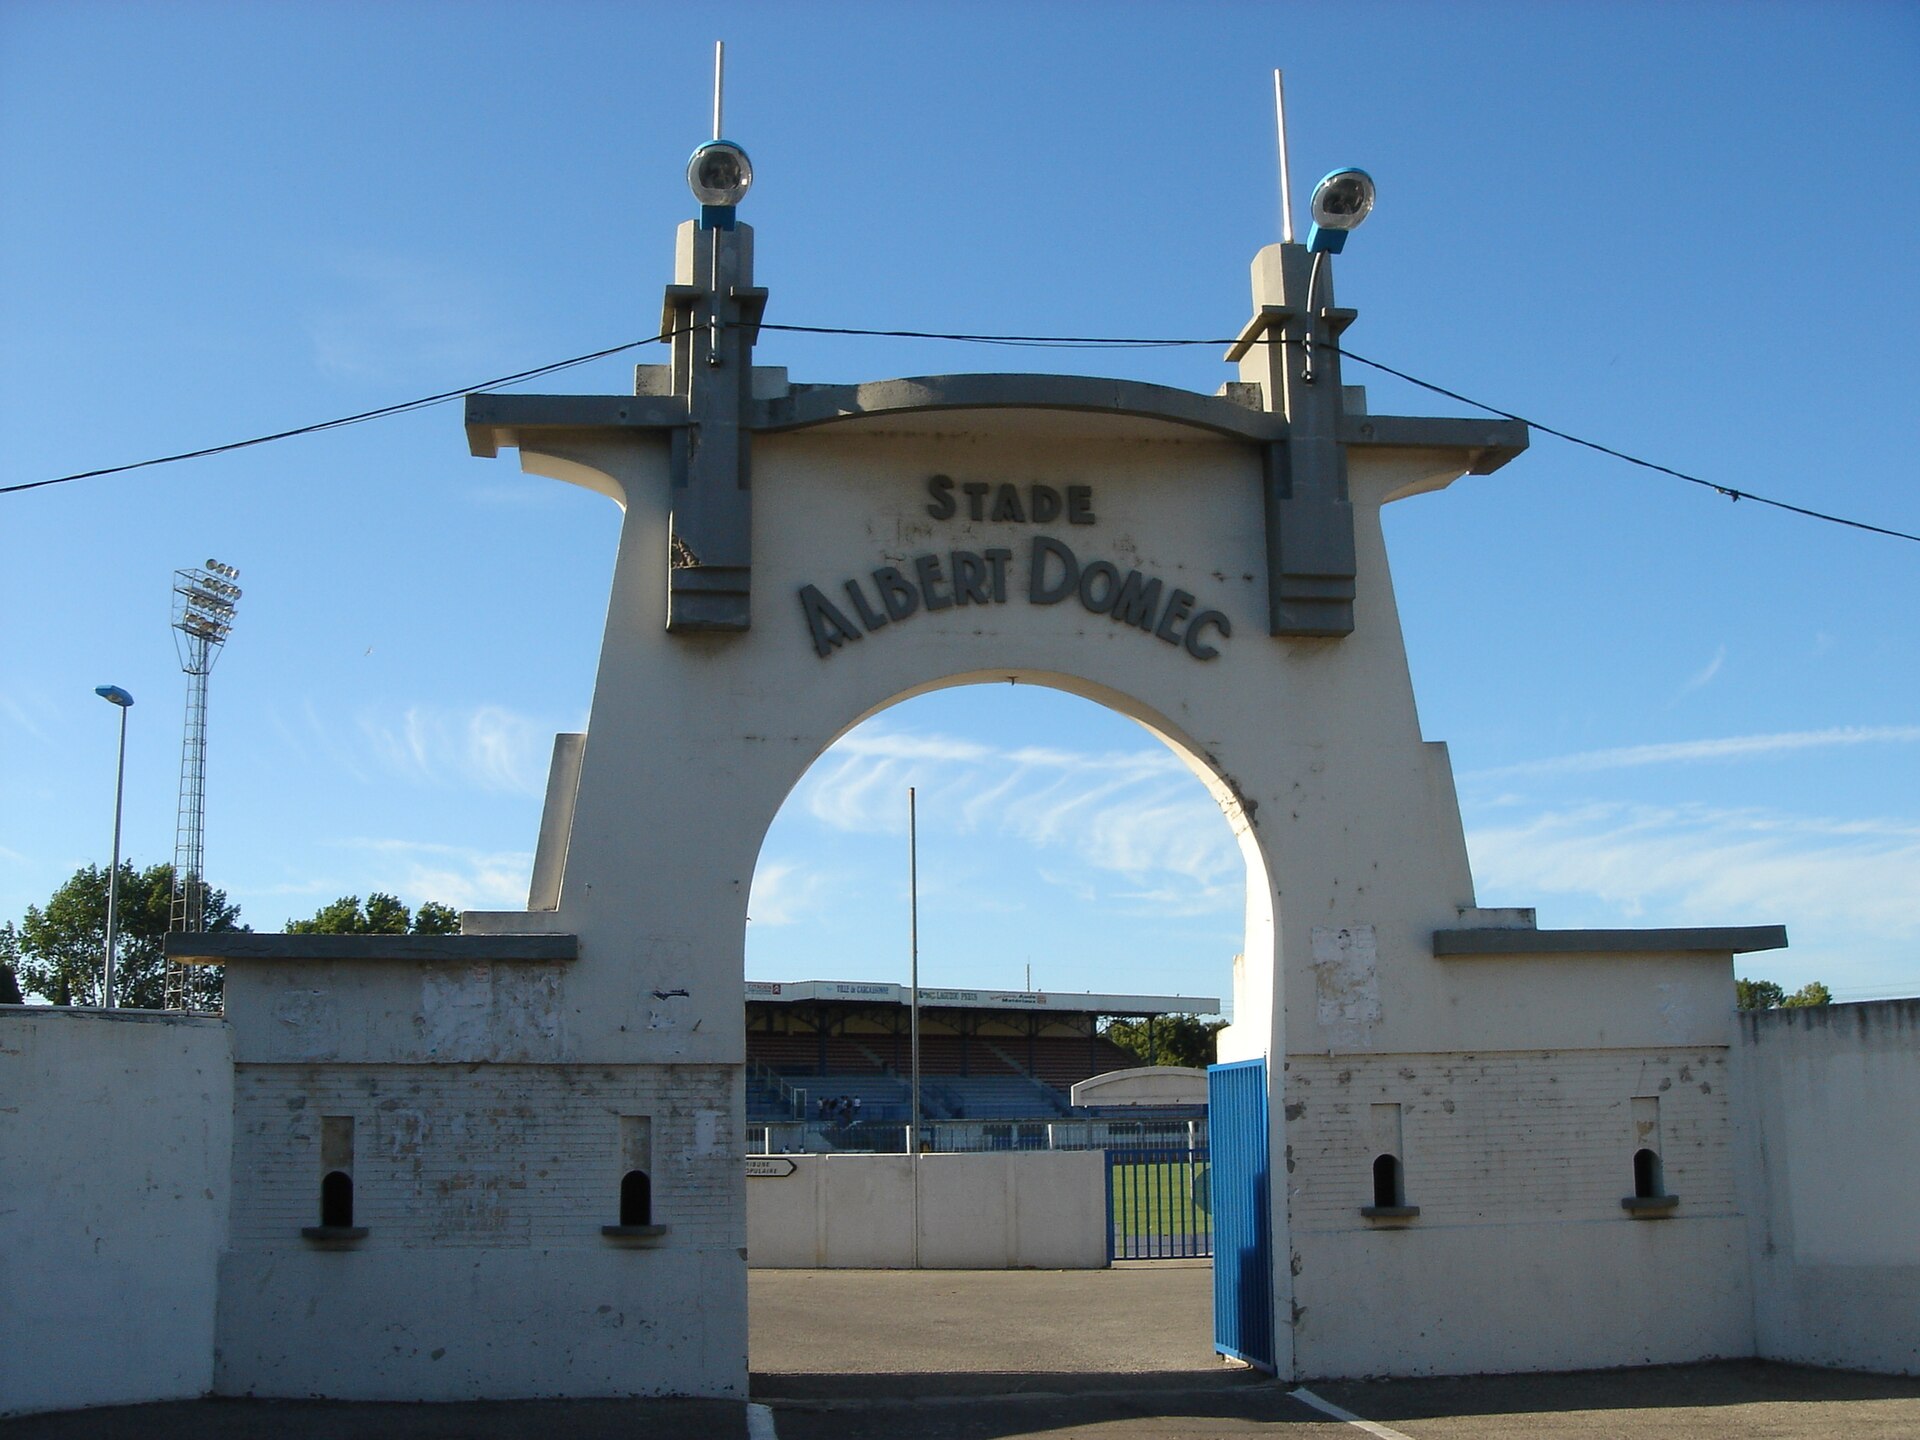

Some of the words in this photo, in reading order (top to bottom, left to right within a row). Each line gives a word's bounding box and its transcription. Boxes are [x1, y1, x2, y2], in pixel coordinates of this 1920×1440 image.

[927, 474, 1096, 525] STADE
[799, 548, 1012, 658] ALBERT
[1029, 535, 1232, 661] DOMEC
